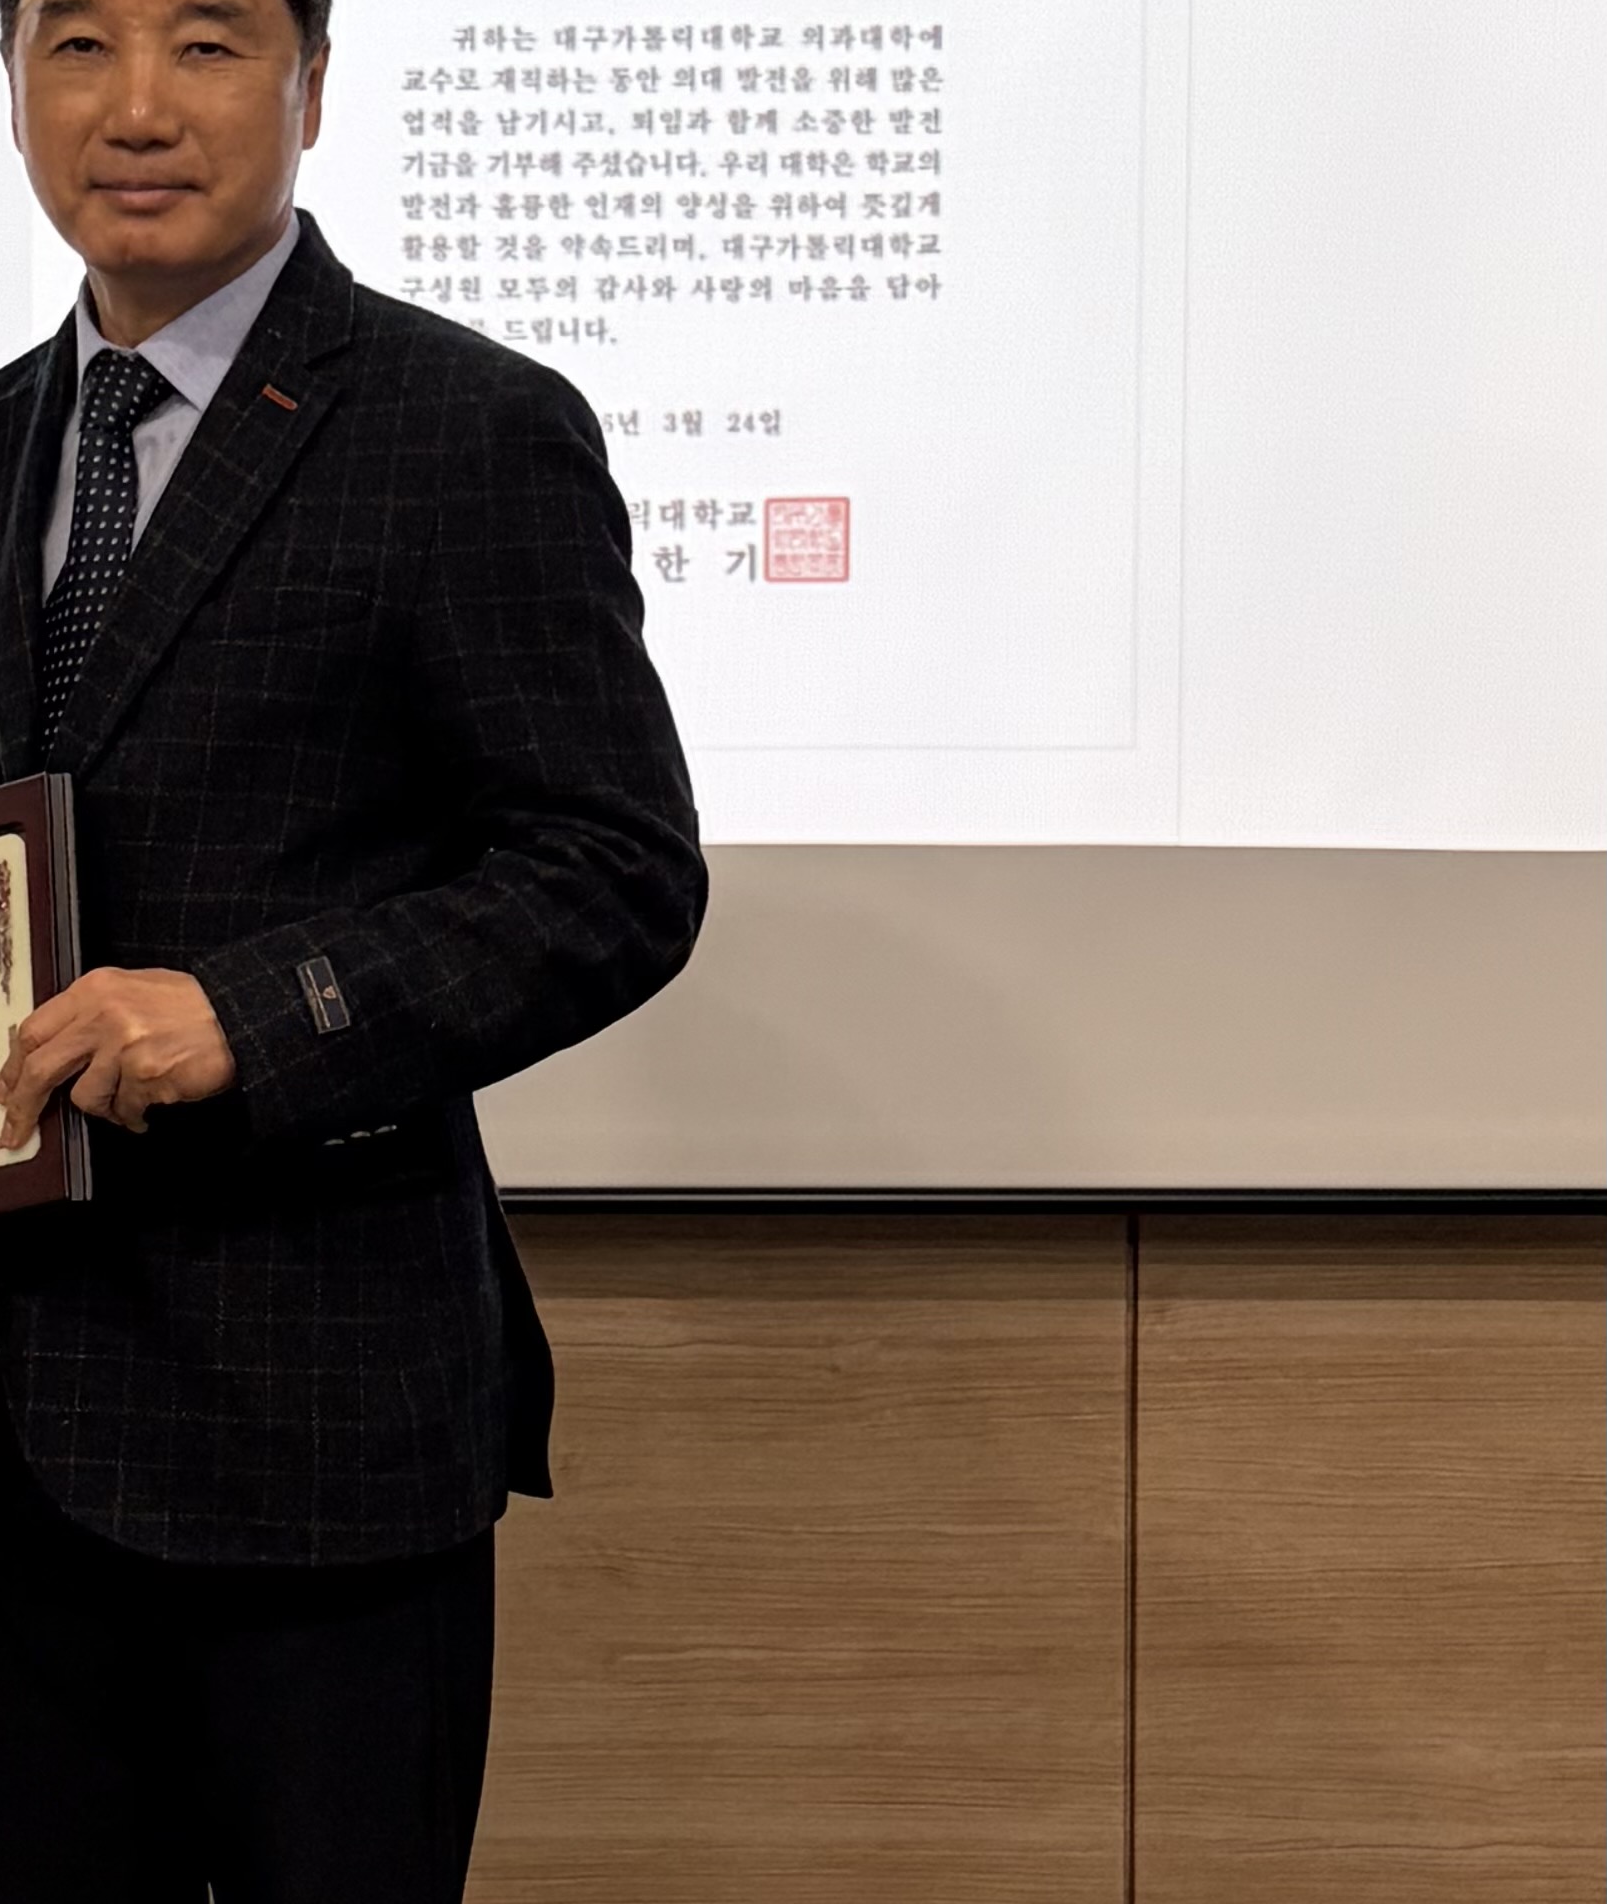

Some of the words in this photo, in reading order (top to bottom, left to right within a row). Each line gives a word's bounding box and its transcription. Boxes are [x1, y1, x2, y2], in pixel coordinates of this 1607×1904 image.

[452, 24, 537, 52] 귀하는
[553, 23, 783, 52] 대구가톨릭대학교
[802, 24, 943, 52] 의과대학에
[401, 66, 481, 94] 교수로
[493, 66, 597, 94] 재직하는
[609, 65, 661, 94] 동안
[672, 65, 723, 92] 의대
[736, 65, 814, 94] 발전을
[828, 66, 878, 93] 위해
[890, 66, 944, 93] 많은
[402, 108, 483, 136] 업적을
[632, 107, 713, 136] 퇴임과
[727, 108, 778, 135] 함께
[793, 108, 876, 136] 소중한
[888, 107, 943, 135] 발전
[402, 150, 478, 179] 기금을
[488, 150, 562, 178] 기부해
[718, 150, 768, 178] 우리
[779, 150, 855, 178] 대학은
[865, 148, 941, 177] 학교의
[401, 192, 481, 221] 발전과
[584, 191, 662, 220] 인재의
[676, 191, 757, 220] 양성을
[769, 191, 847, 219] 위하여
[402, 234, 482, 262] 활용할
[496, 234, 547, 261] 것을
[721, 232, 942, 261] 대구가톨릭대학교
[399, 274, 482, 304] 구성원
[497, 275, 577, 302] 모두의
[596, 274, 678, 302] 감사와
[691, 275, 772, 303] 사랑의
[788, 274, 872, 302] 마음을
[886, 272, 942, 301] 담아
[502, 315, 618, 345] 드립니다.
[663, 409, 704, 437] 3월
[726, 409, 782, 437] 24일
